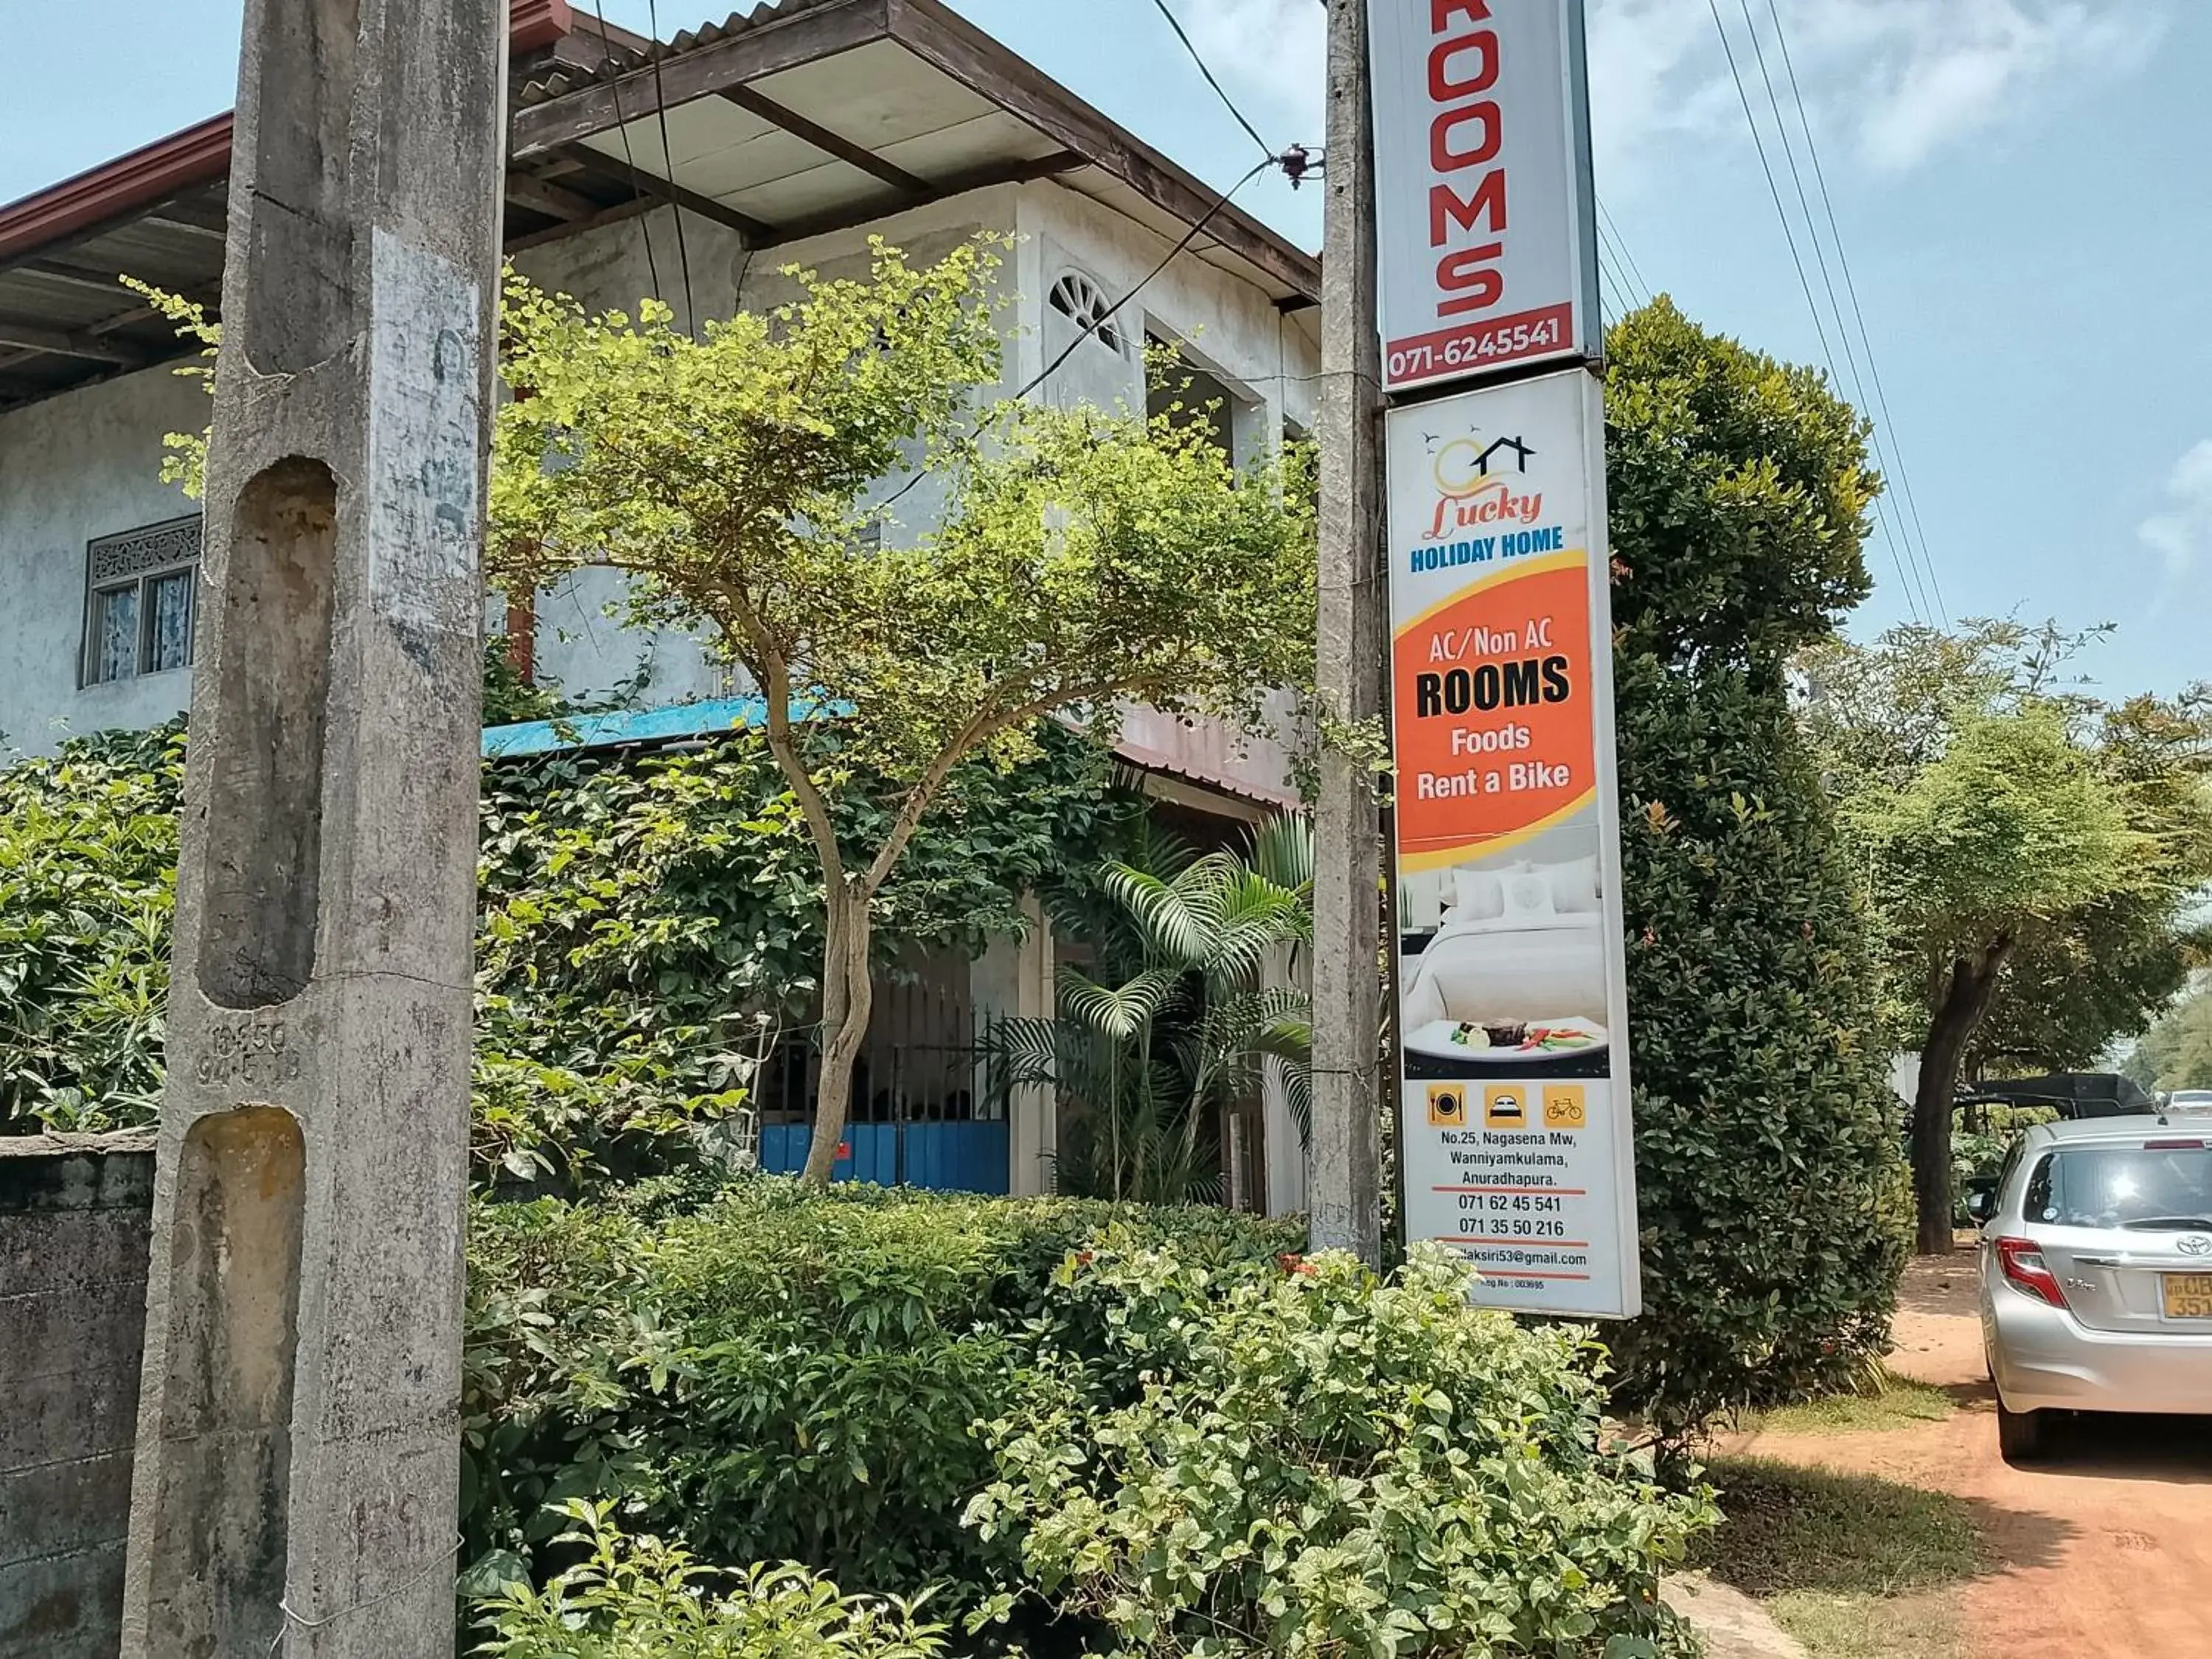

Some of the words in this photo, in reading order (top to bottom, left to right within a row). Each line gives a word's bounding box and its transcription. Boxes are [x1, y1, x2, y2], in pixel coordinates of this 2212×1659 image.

[1388, 318, 1559, 378] 071-6245541
[1422, 482, 1543, 540] Lucky
[1411, 536, 1496, 573] HOLIDAY
[1501, 526, 1563, 557] HOME
[1429, 627, 1516, 662] AC/Non
[1524, 616, 1553, 649] AC
[1416, 655, 1569, 718] ROOMS
[1451, 722, 1531, 756] Foods
[1417, 769, 1478, 800] Rent
[1485, 771, 1500, 793] a
[1509, 762, 1569, 791] Bike
[1441, 1132, 1479, 1146] No.25,
[1483, 1133, 1545, 1147] Nagasena
[1550, 1133, 1576, 1147] Mw,
[1450, 1151, 1568, 1168] Wanniyamkulama,
[1462, 1172, 1557, 1187] Anuradhapura.
[1458, 1194, 1484, 1209] 071
[1489, 1195, 1507, 1210] 62
[1513, 1196, 1530, 1211] 45
[1535, 1197, 1560, 1211] 541
[1459, 1218, 1484, 1233] 071
[1491, 1219, 1508, 1234] 35
[1514, 1220, 1531, 1234] 50
[1537, 1221, 1564, 1236] 216
